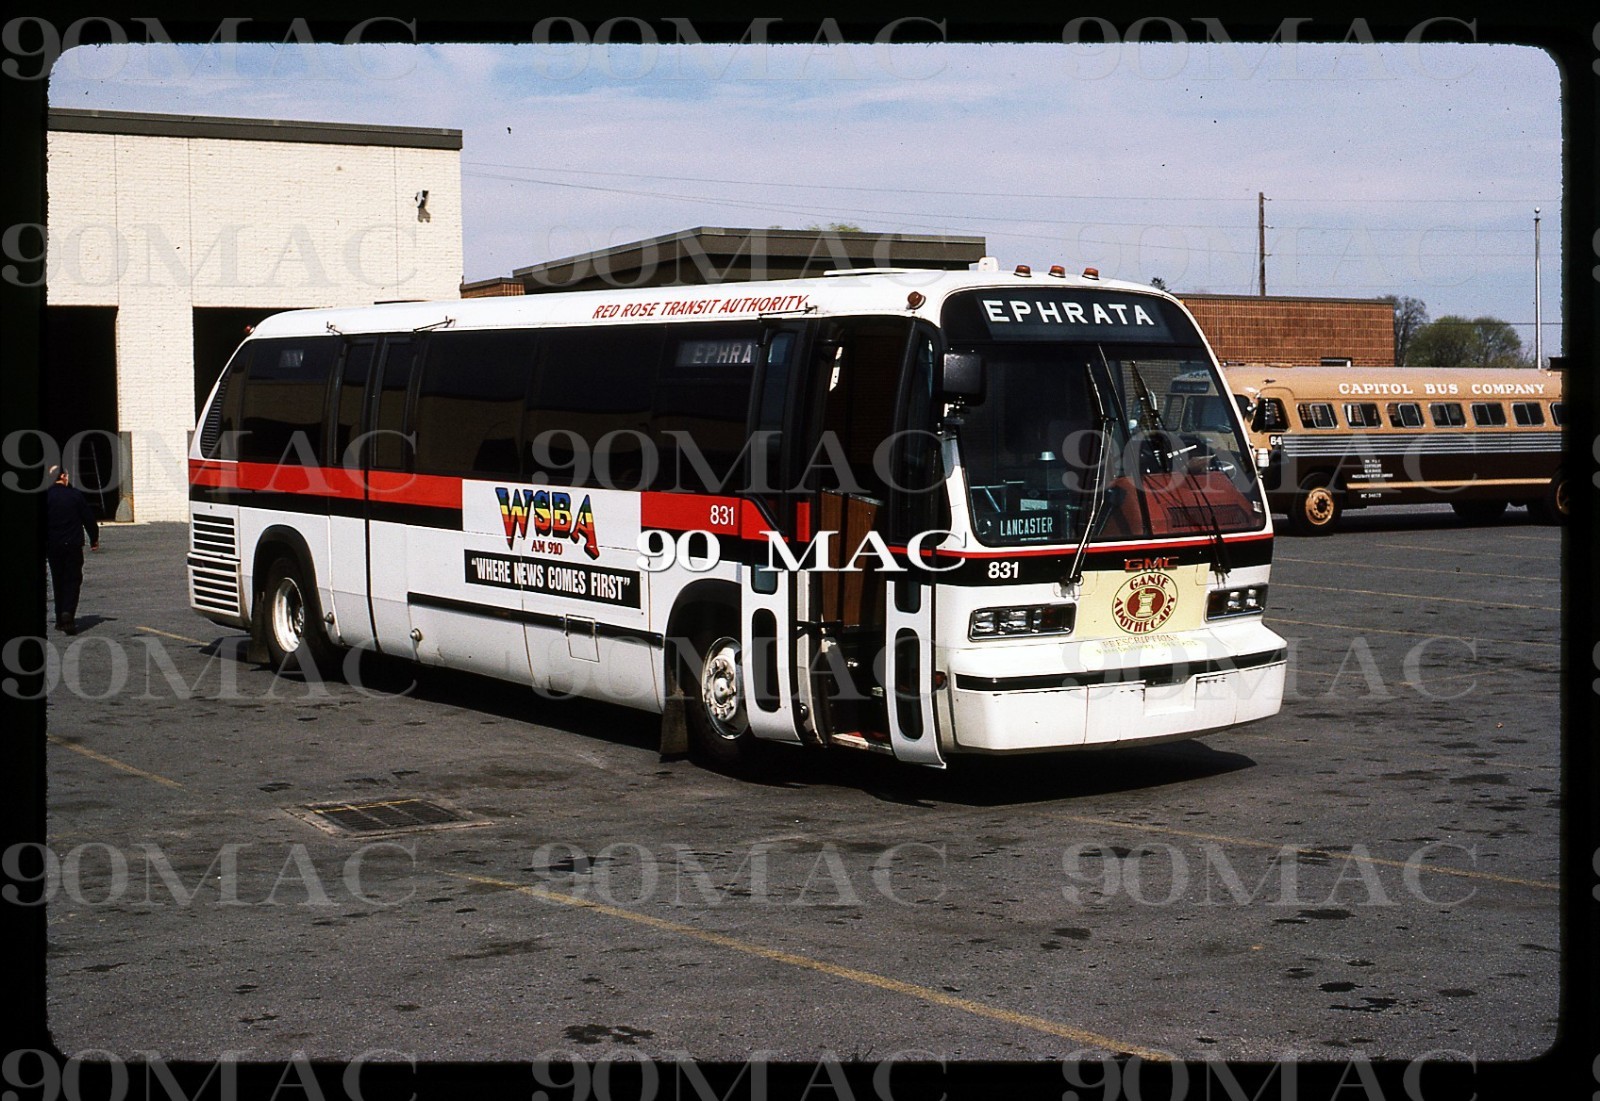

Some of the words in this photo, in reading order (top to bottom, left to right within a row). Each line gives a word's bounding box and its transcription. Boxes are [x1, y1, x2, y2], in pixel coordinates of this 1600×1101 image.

[592, 305, 621, 319] RED
[620, 302, 660, 318] ROSE
[661, 299, 721, 316] TRANSIT
[718, 294, 809, 313] AUTHORITY
[982, 300, 1154, 325] EPHRATA
[692, 343, 774, 364] EPHRA
[1338, 383, 1413, 395] CAPITOL
[1424, 383, 1459, 394] BUS
[1471, 383, 1545, 395] COMPANY
[495, 487, 600, 560] WSBA
[710, 505, 735, 526] 831
[1000, 516, 1054, 537] LANCASTER
[531, 540, 546, 553] AM
[547, 540, 563, 555] 910
[987, 561, 1019, 579] 831
[1124, 557, 1179, 572] GMC
[513, 561, 545, 587] NEWS
[547, 566, 586, 595] COMES
[1129, 574, 1169, 590] GANSE
[1114, 594, 1175, 632] APOTHECARY
